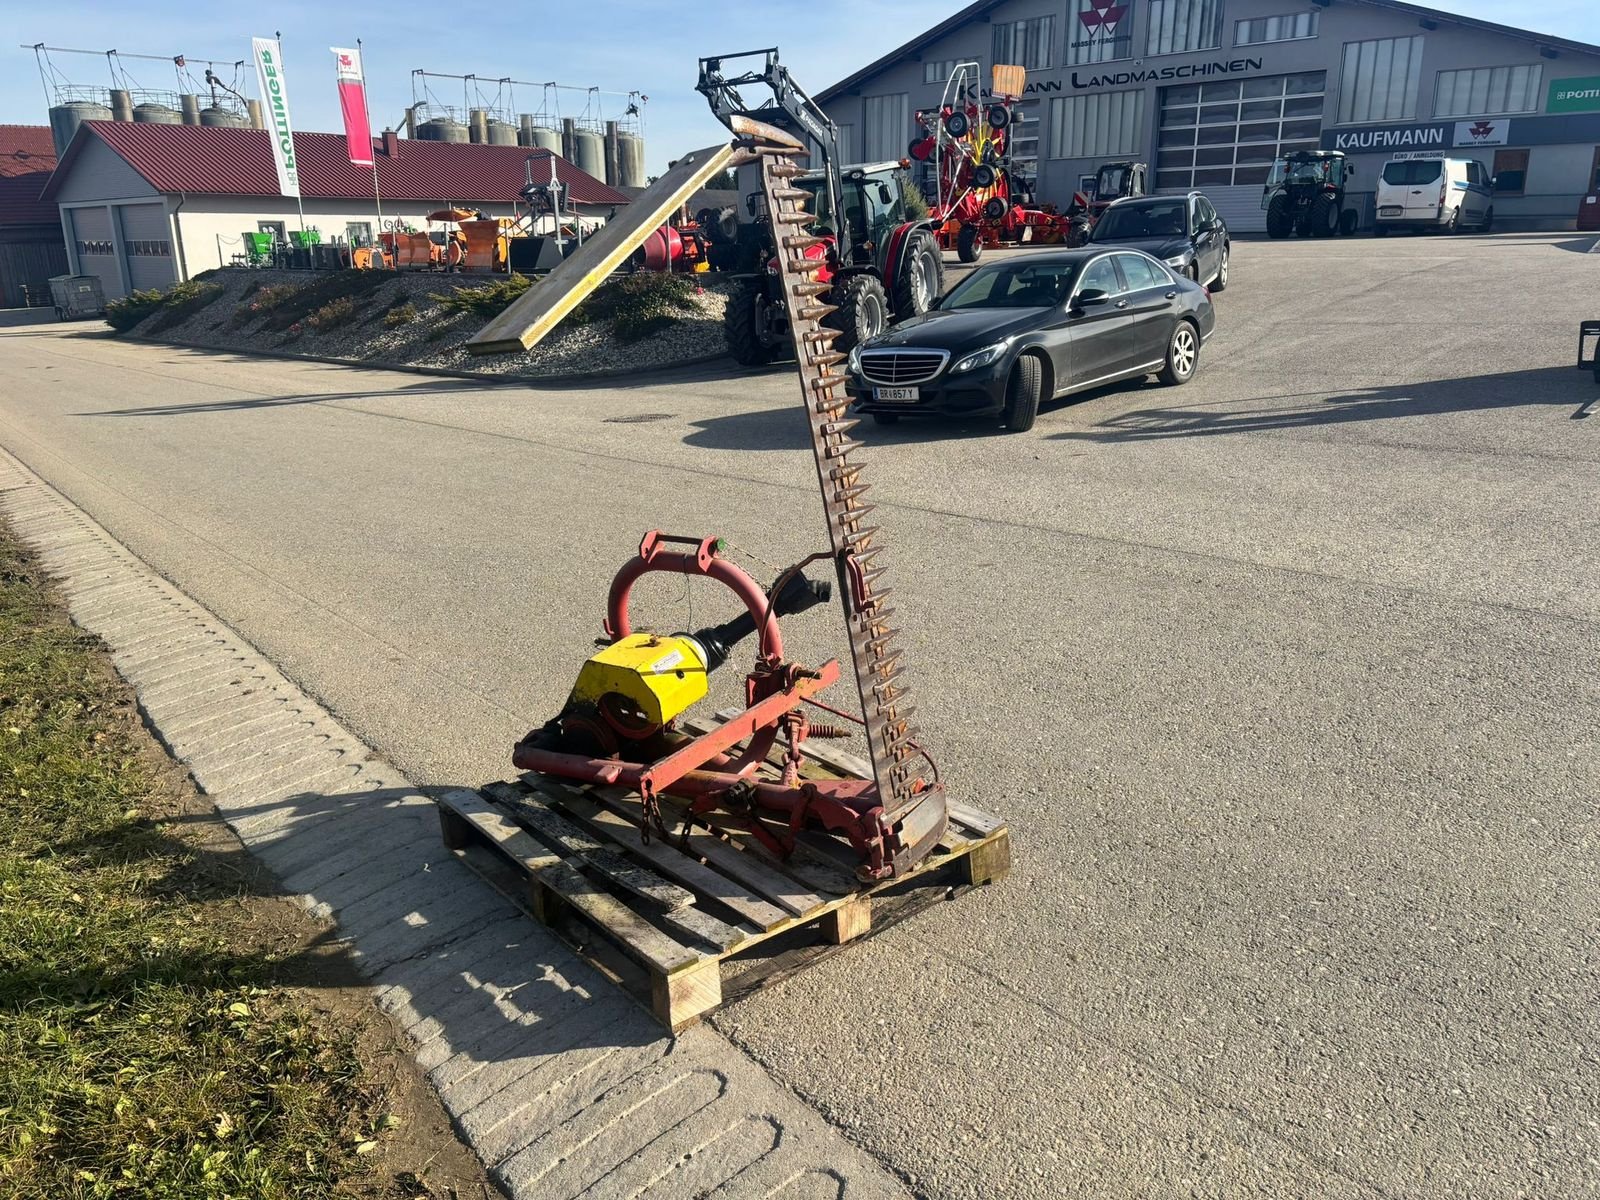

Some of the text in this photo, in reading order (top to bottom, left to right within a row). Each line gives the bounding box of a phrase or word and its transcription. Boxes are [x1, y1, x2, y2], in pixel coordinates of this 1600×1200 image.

[1071, 40, 1097, 48] MASSEY
[1072, 57, 1262, 89] LANDMASCHINEN
[1335, 128, 1444, 149] KAUFMANN
